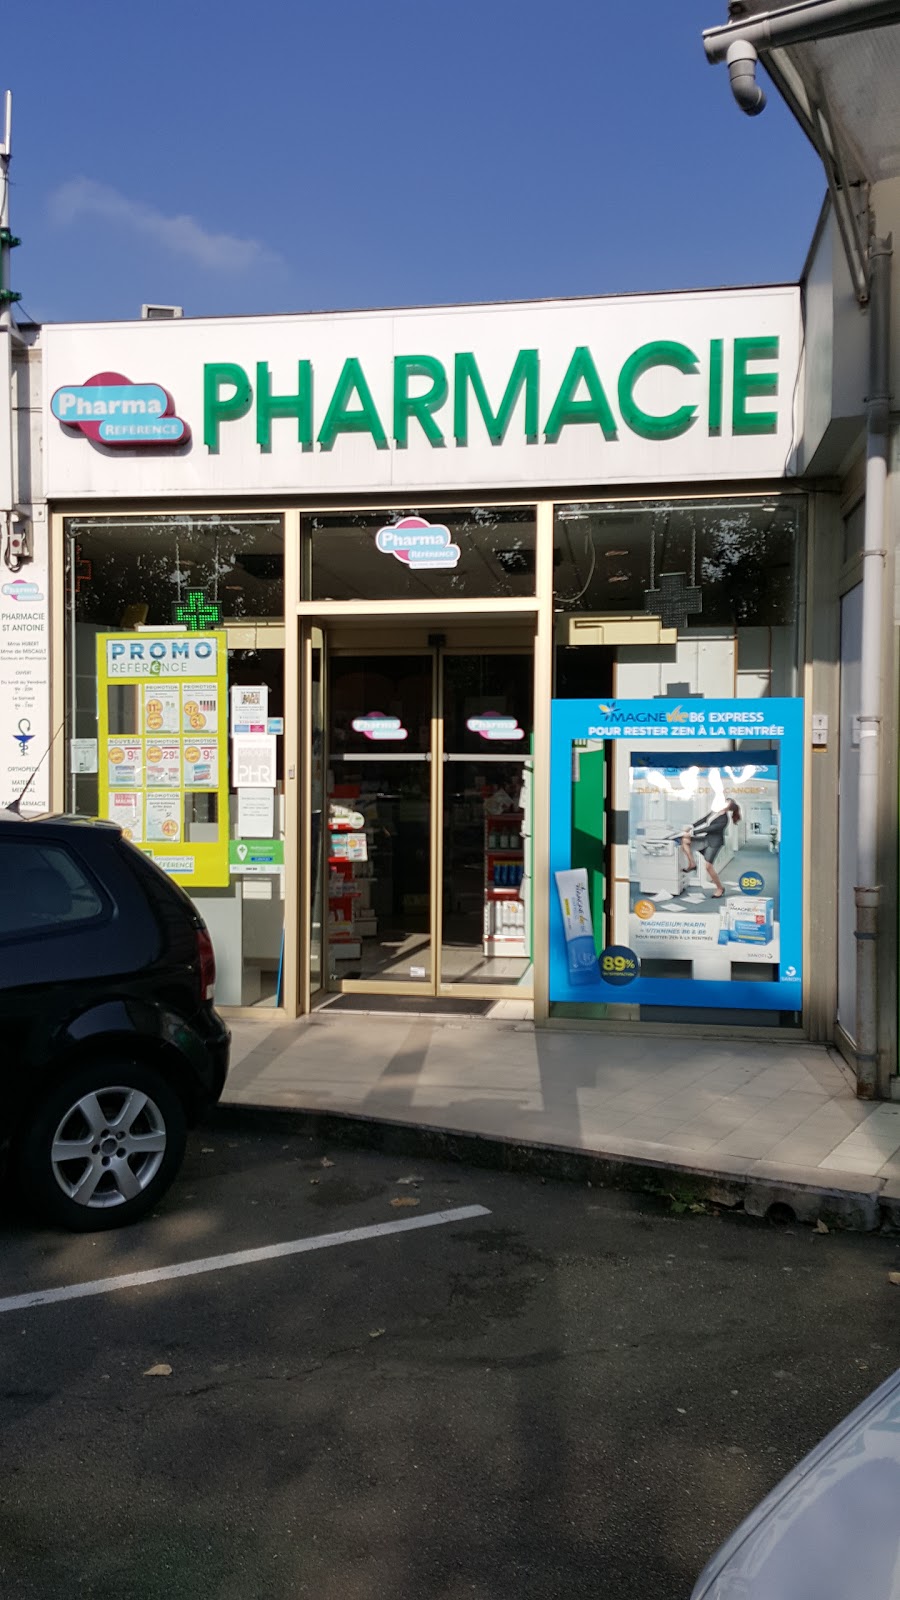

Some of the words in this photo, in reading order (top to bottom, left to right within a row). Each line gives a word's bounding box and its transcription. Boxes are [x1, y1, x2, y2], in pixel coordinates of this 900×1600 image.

[203, 335, 780, 454] PHARMACIE
[59, 392, 163, 416] Pharma
[382, 531, 445, 547] Pharma
[1, 612, 45, 620] PHARMACIE
[111, 642, 212, 660] PROMO
[689, 712, 705, 723] B6
[709, 712, 765, 723] EXPRESS
[588, 726, 621, 736] POUR
[624, 726, 668, 736] RESTER
[671, 725, 695, 736] ZEN
[697, 724, 707, 736] À
[709, 726, 726, 736] LA
[728, 724, 785, 736] RENTRÉE
[239, 765, 270, 783] PHR
[602, 956, 636, 972] 89%
